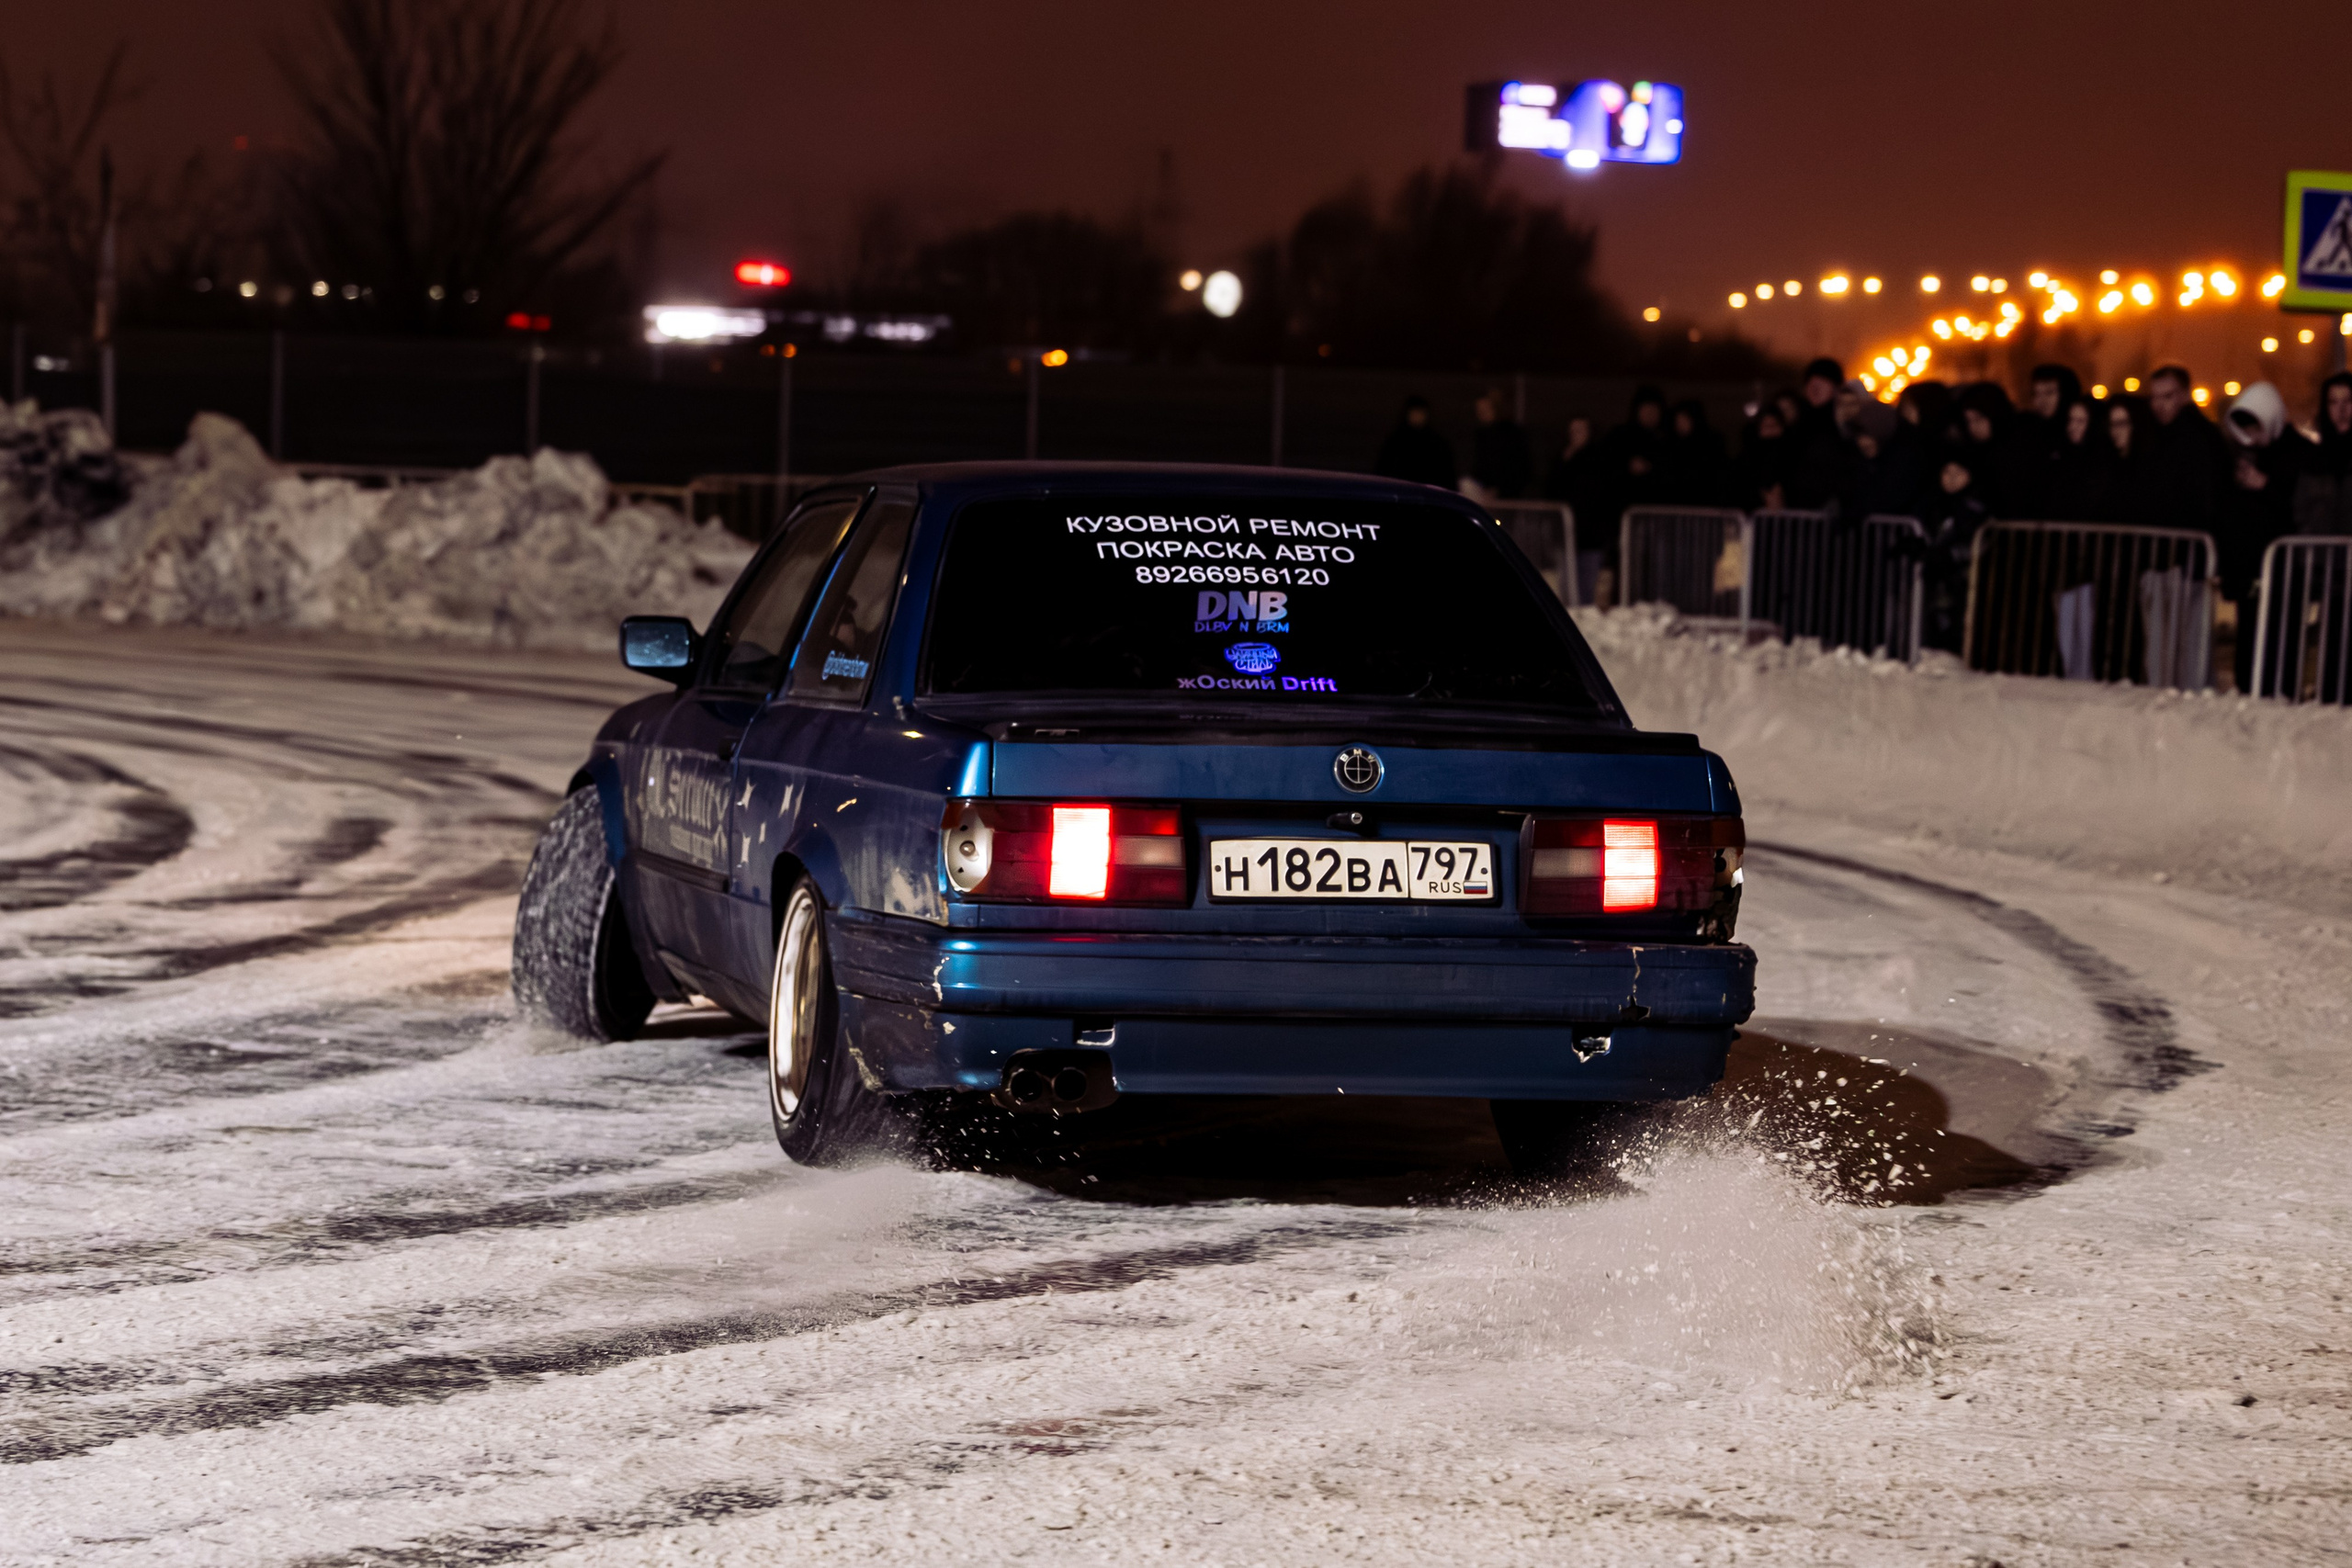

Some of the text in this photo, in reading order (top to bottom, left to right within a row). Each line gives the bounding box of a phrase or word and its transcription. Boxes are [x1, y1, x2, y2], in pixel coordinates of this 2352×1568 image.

[1067, 515, 1381, 540] КУЗОВНОЙ РЕМОНТ
[1097, 541, 1354, 563] ПОКРАСКА АВТО
[1136, 566, 1329, 585] 89266956120
[1197, 591, 1288, 621] DNB
[1239, 622, 1250, 633] N
[1256, 622, 1290, 633] BRM
[1282, 675, 1338, 692] Drift
[1411, 847, 1477, 881] 797
[1429, 881, 1462, 894] RUS
